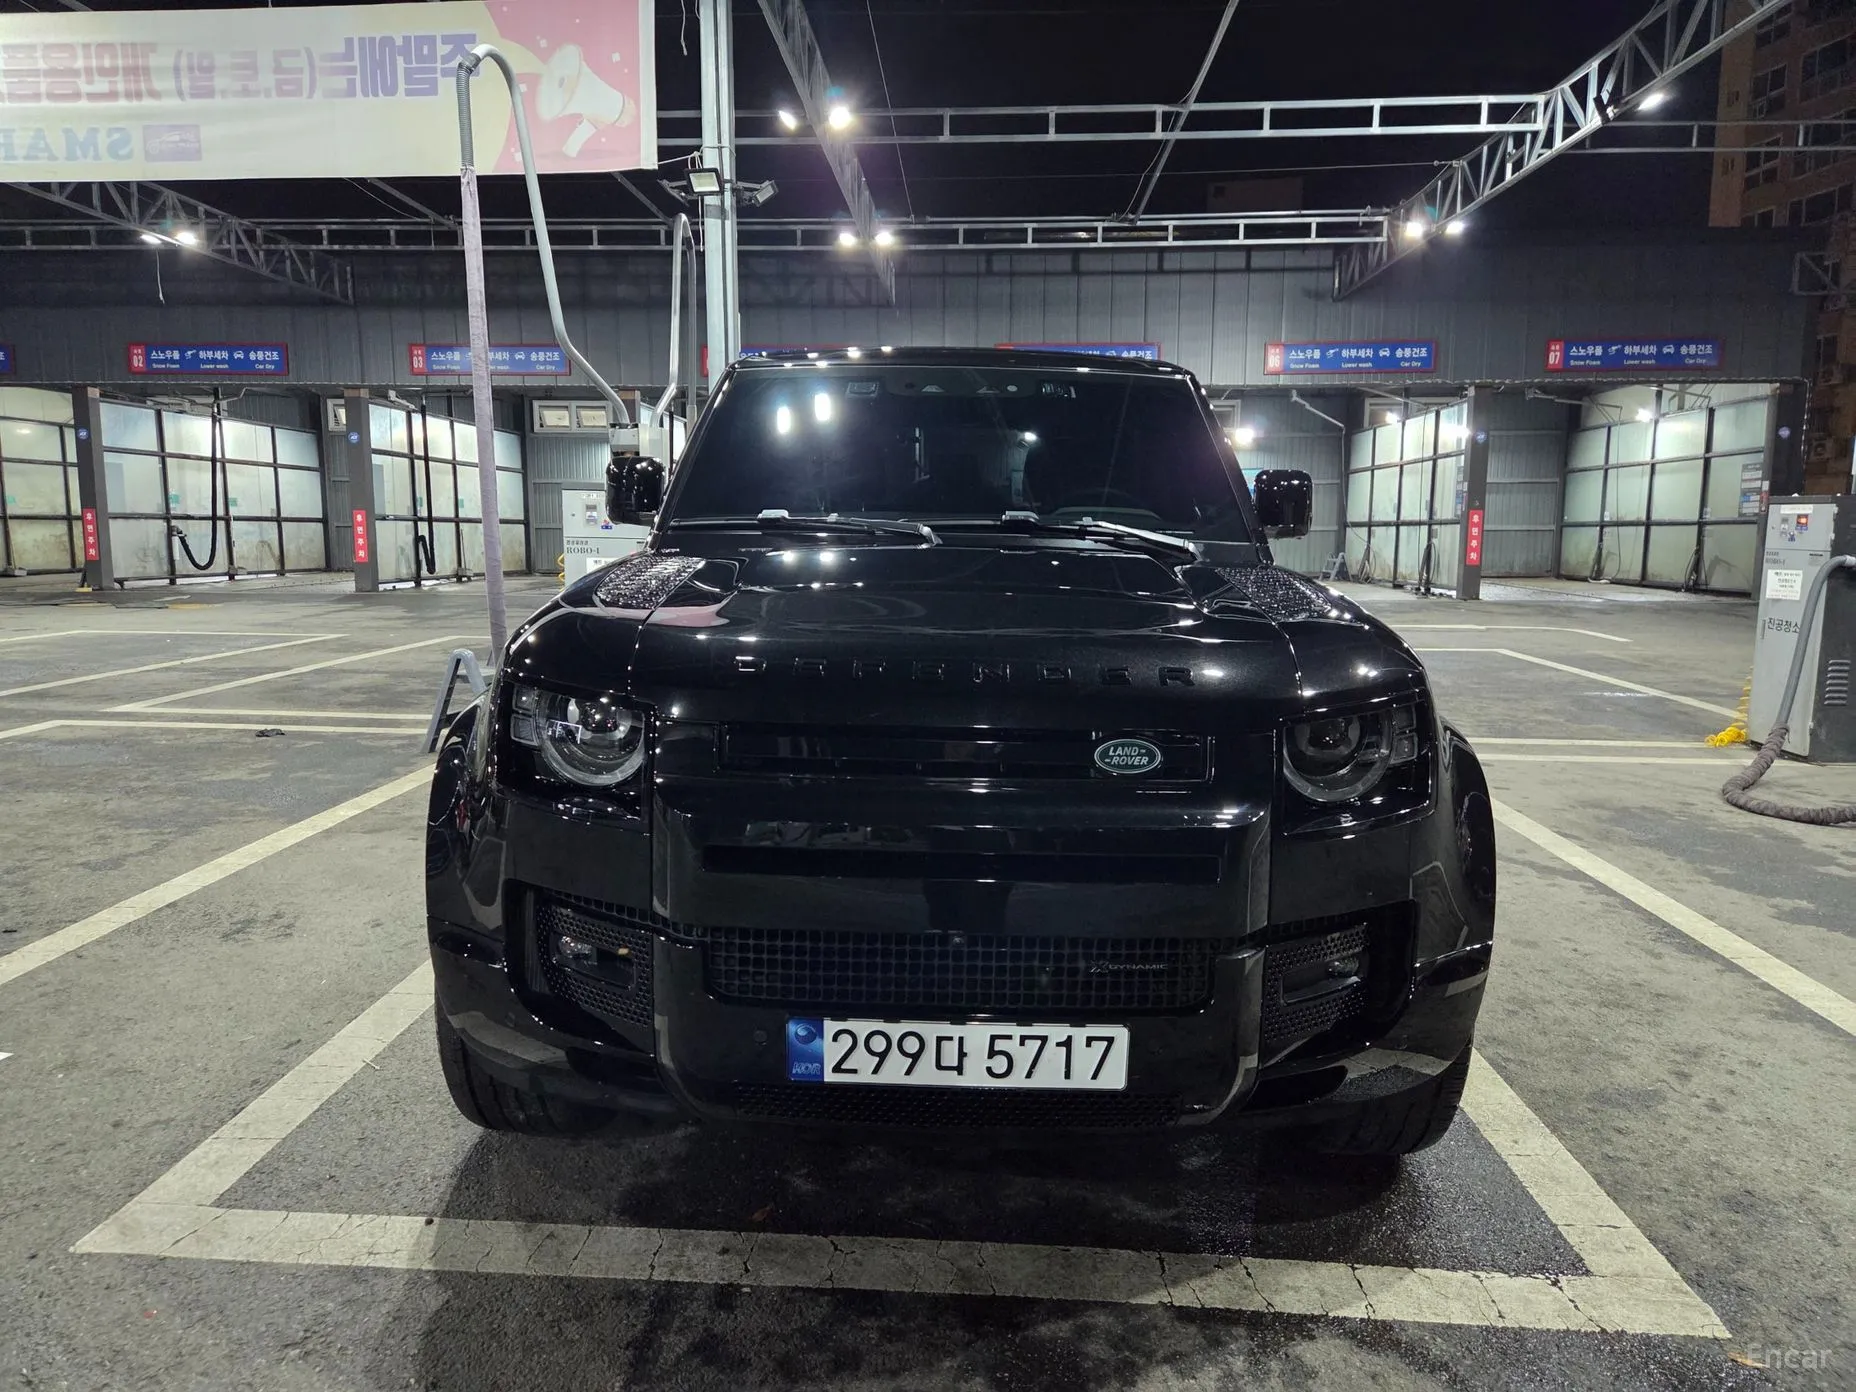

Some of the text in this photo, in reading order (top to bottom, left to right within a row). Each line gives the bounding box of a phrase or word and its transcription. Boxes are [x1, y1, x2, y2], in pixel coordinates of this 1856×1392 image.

[199, 350, 228, 360] 하부세차
[487, 351, 510, 361] 부세차
[1341, 348, 1373, 358] 하부세차
[1624, 345, 1657, 355] 하부세차
[132, 355, 143, 367] 02
[412, 356, 423, 368] 03
[1549, 352, 1560, 364] 07
[734, 655, 1195, 687] DEFENDER
[830, 1028, 1116, 1080] 299다 5717
